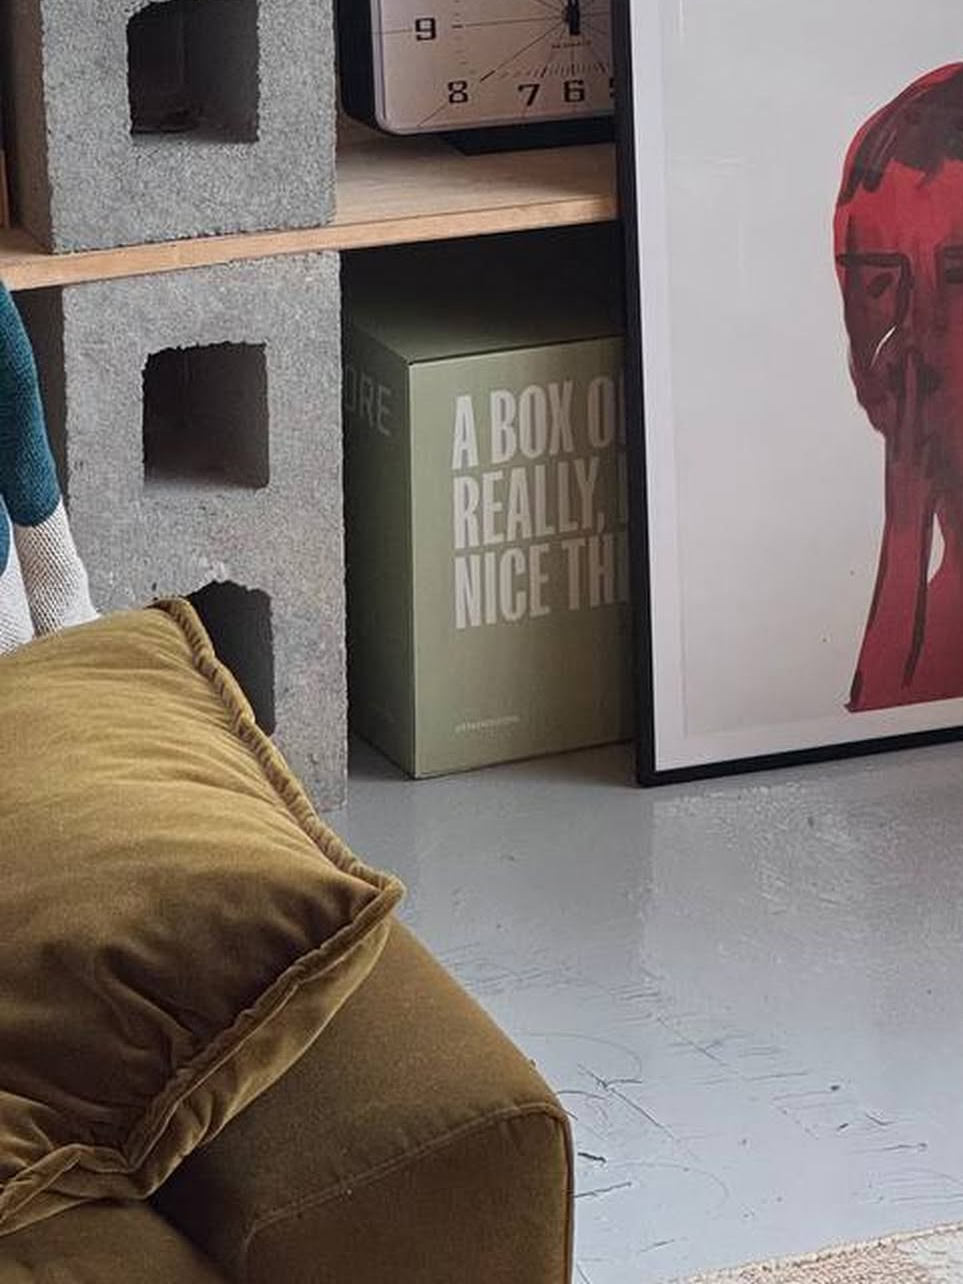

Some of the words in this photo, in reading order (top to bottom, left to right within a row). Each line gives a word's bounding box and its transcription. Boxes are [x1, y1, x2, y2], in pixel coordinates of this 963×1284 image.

[415, 18, 436, 41] 9
[448, 81, 468, 104] 8
[518, 83, 540, 106] 7
[563, 80, 585, 103] 6
[453, 395, 479, 470] A
[491, 379, 573, 464] BOX
[453, 456, 605, 549] REALLY,
[454, 544, 550, 629] NICE
